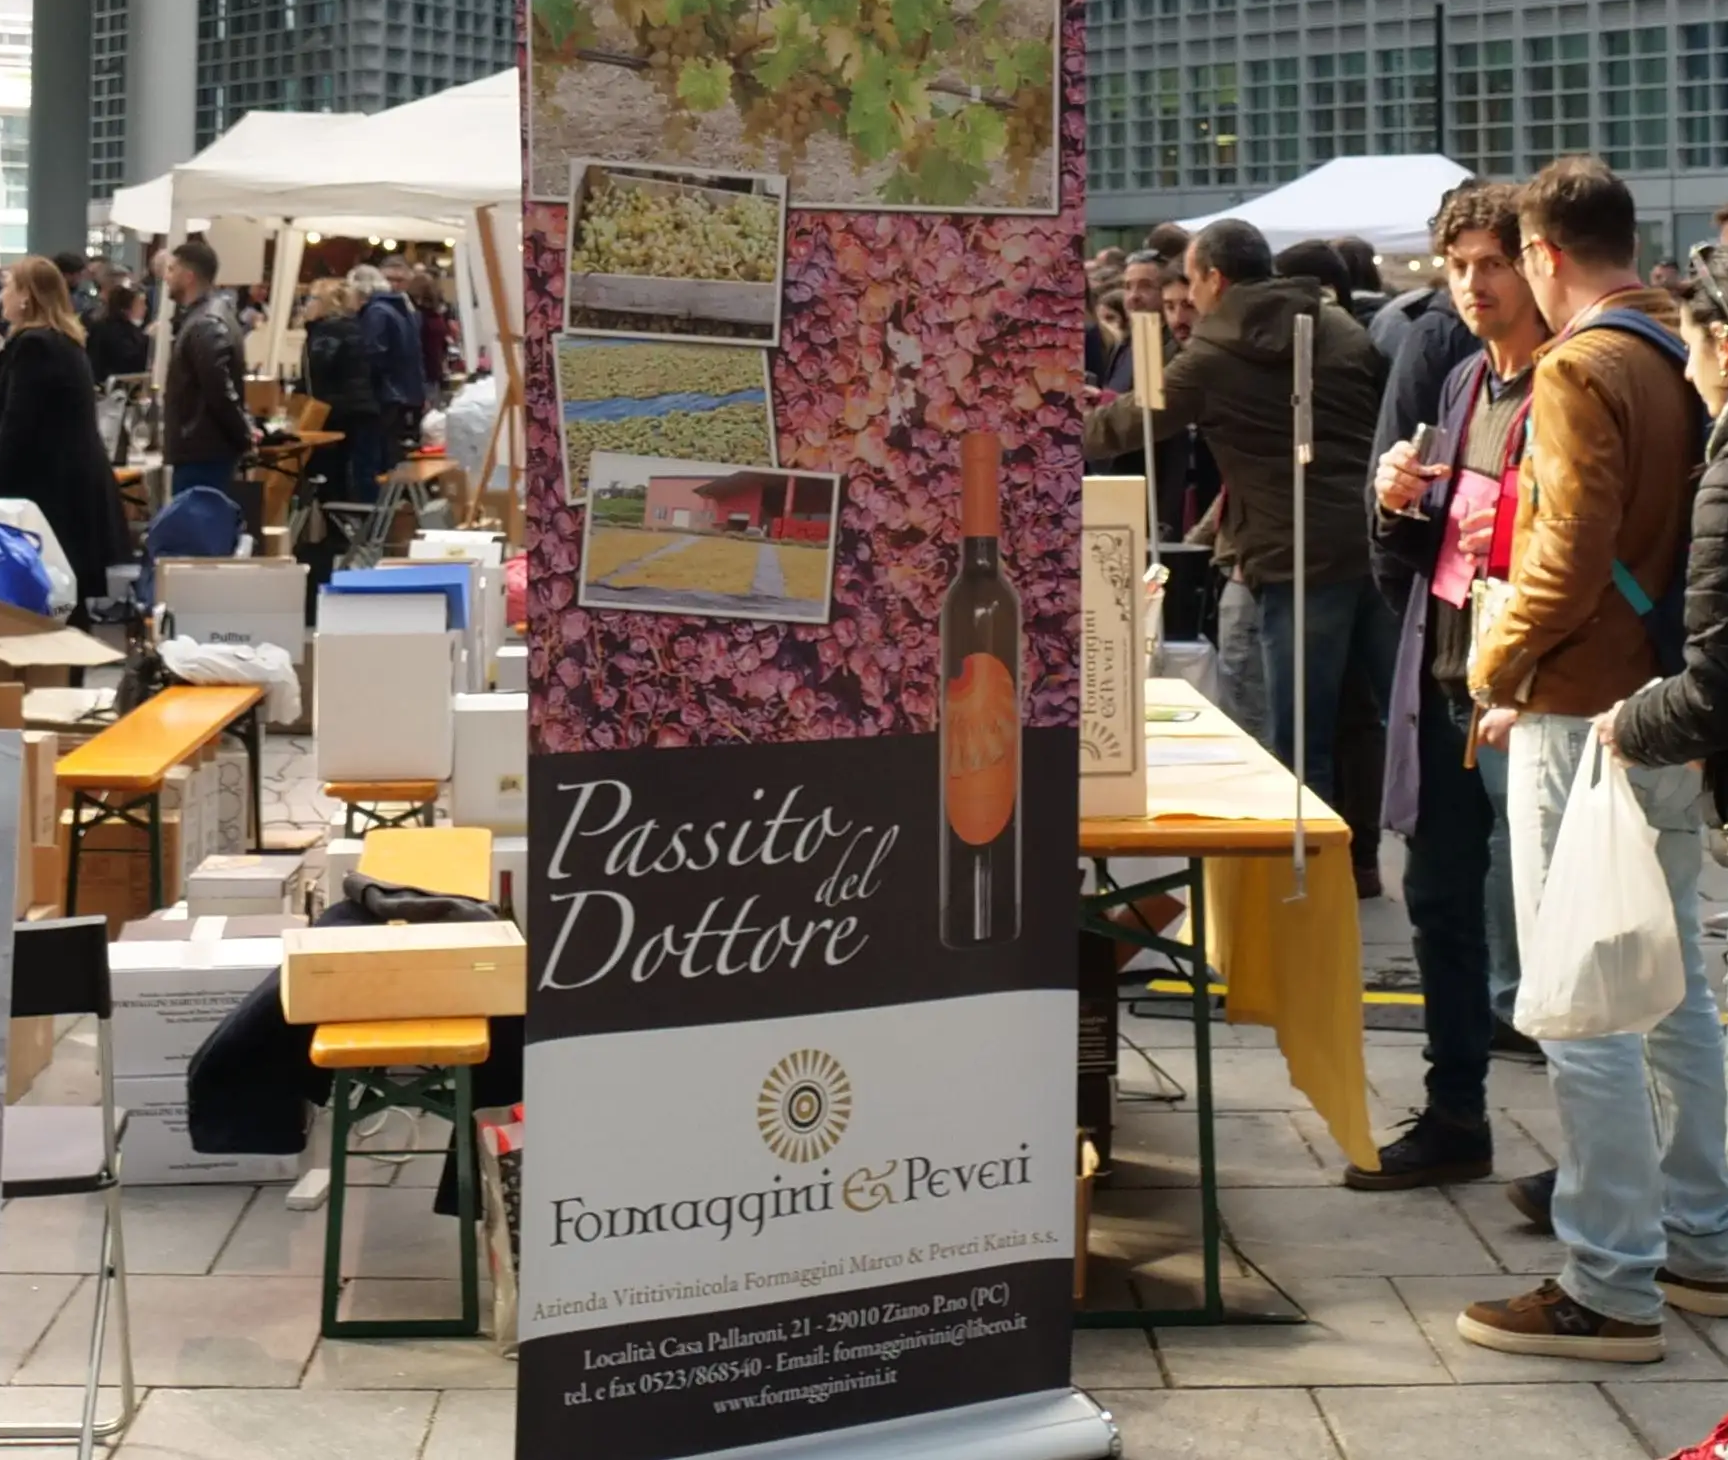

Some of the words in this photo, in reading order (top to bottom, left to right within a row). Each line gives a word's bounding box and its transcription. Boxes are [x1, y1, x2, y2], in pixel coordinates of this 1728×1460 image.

[547, 779, 853, 880] Passito
[814, 824, 901, 908] del
[537, 890, 870, 992] Dottore
[549, 1167, 835, 1247] Formaggini
[841, 1160, 899, 1213] &
[903, 1142, 1032, 1202] Peveri
[532, 1292, 608, 1321] Azienda
[613, 1274, 738, 1307] Vititivinicola
[744, 1260, 845, 1290] Formaggini
[849, 1253, 903, 1275] Marco
[907, 1247, 924, 1264] &
[929, 1238, 980, 1261] Peveri
[983, 1229, 1028, 1252] Katia
[564, 1382, 593, 1406] tel.
[595, 1385, 607, 1401] e
[608, 1377, 637, 1399] fax
[639, 1357, 762, 1394] 0523/868540
[775, 1344, 830, 1373] Email:
[833, 1312, 1028, 1363] formagginivini@libero.it
[583, 1340, 656, 1371] Località
[659, 1337, 704, 1359] Casa
[707, 1322, 788, 1352] Pallaroni,
[791, 1317, 810, 1339] 21
[827, 1307, 879, 1333] 29010
[881, 1299, 930, 1324] Ziano
[933, 1294, 968, 1315] P.no
[970, 1281, 1011, 1312] (PC)
[713, 1367, 898, 1414] www.formagginivini.it
